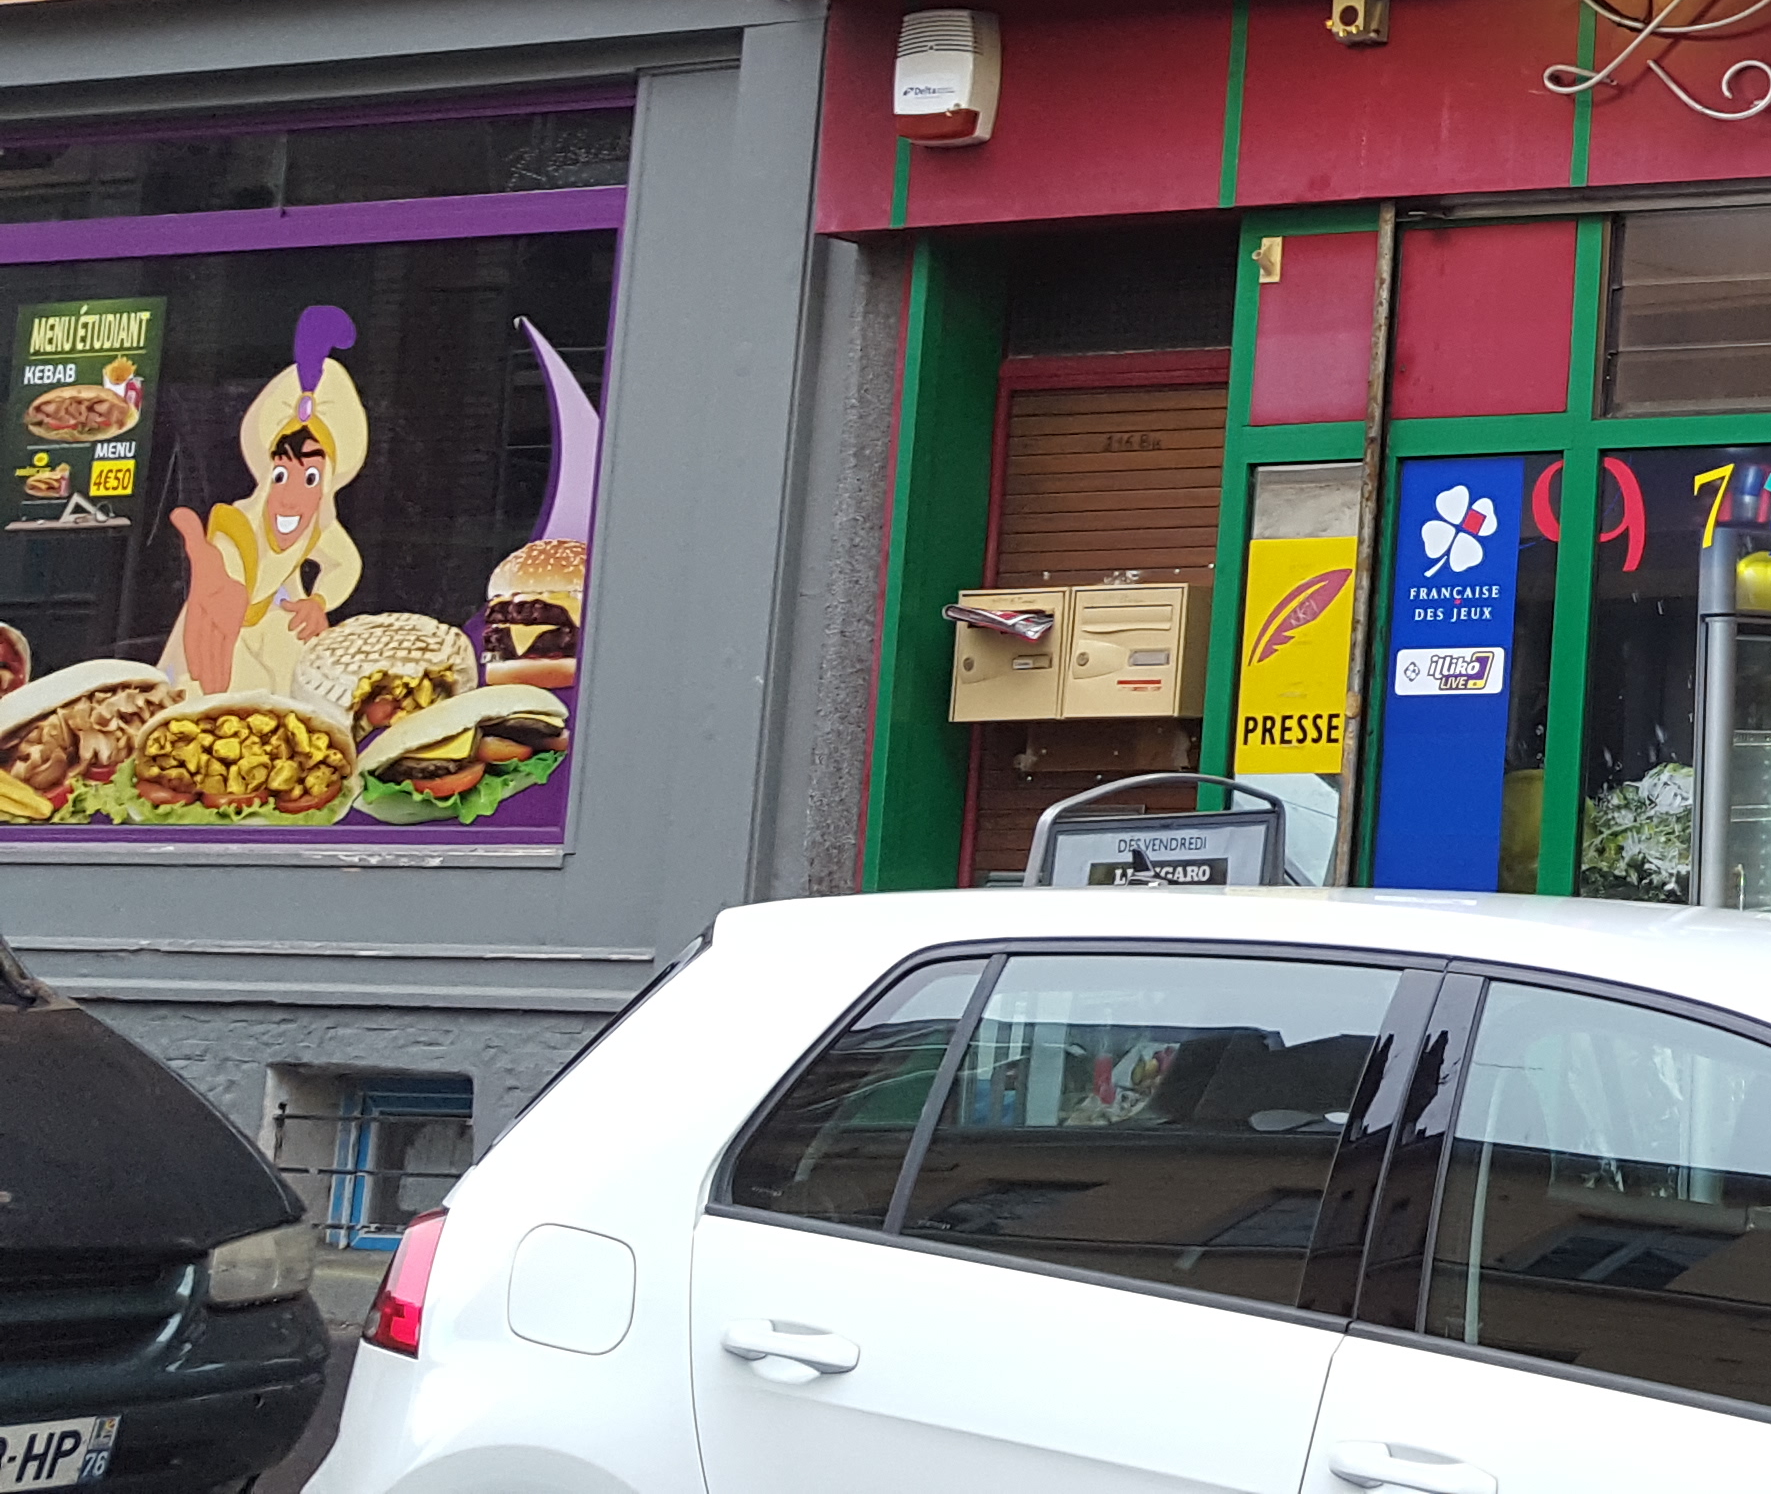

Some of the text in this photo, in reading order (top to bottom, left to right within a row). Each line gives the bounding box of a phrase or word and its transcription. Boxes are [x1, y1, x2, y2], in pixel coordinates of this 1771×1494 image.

[30, 304, 151, 354] MENU ÉTUDIANT
[23, 364, 77, 385] KEBAB
[95, 441, 136, 459] MENU
[92, 468, 132, 492] 4€50
[1693, 463, 1736, 549] 7
[1409, 585, 1500, 603] FRANÇAISE
[1414, 607, 1493, 622] DES JEUX
[1427, 655, 1481, 679] illiko
[1439, 676, 1467, 690] LIVE
[1243, 713, 1341, 746] PRESSE
[1144, 837, 1207, 852] VENDREDI
[82, 1450, 109, 1479] 76
